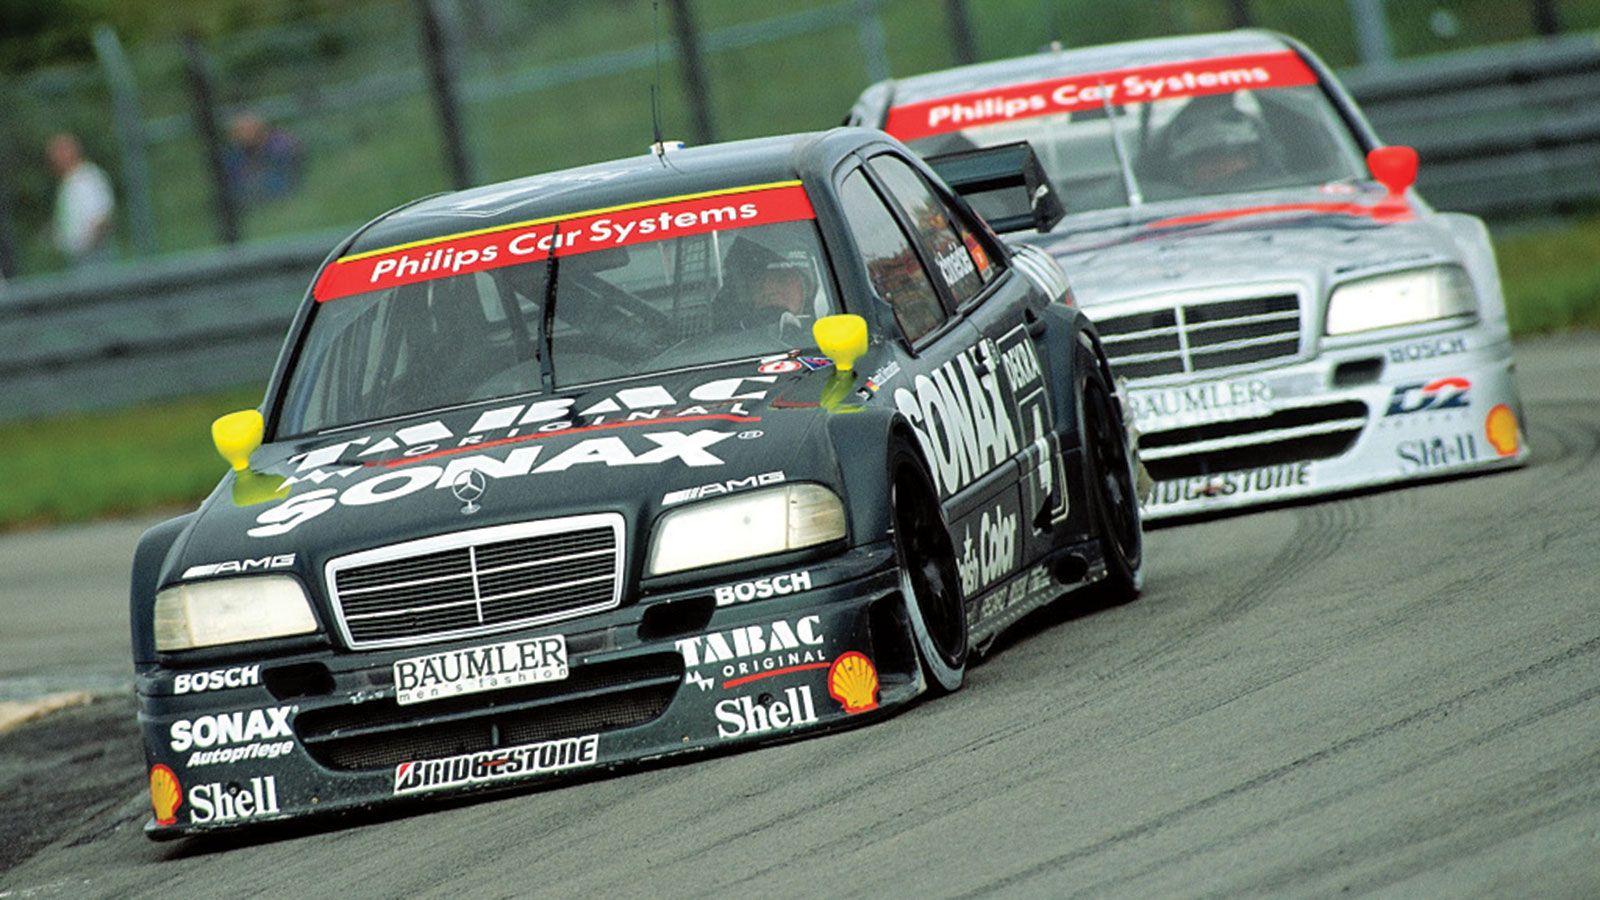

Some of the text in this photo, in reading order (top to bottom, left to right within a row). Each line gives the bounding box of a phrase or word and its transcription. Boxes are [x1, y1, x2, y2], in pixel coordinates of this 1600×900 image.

[928, 64, 1269, 127] Philips Car Systems
[370, 203, 760, 282] Philips Car Systems
[1390, 338, 1466, 362] BOSCH
[287, 376, 778, 473] TABAC
[403, 403, 749, 457] ORIGINAL
[715, 571, 812, 607] BOSCH
[396, 638, 565, 692] BÄUMLER
[675, 615, 824, 668] TABAC
[723, 650, 827, 677] ORIGINAL
[174, 665, 261, 694] BOSCH
[480, 668, 567, 688] fashion
[171, 706, 294, 751] SONAX
[714, 685, 819, 738] Shell
[187, 741, 294, 768] Autopflege
[397, 736, 597, 790] BRIDGESTONE
[188, 776, 281, 823] Shell
